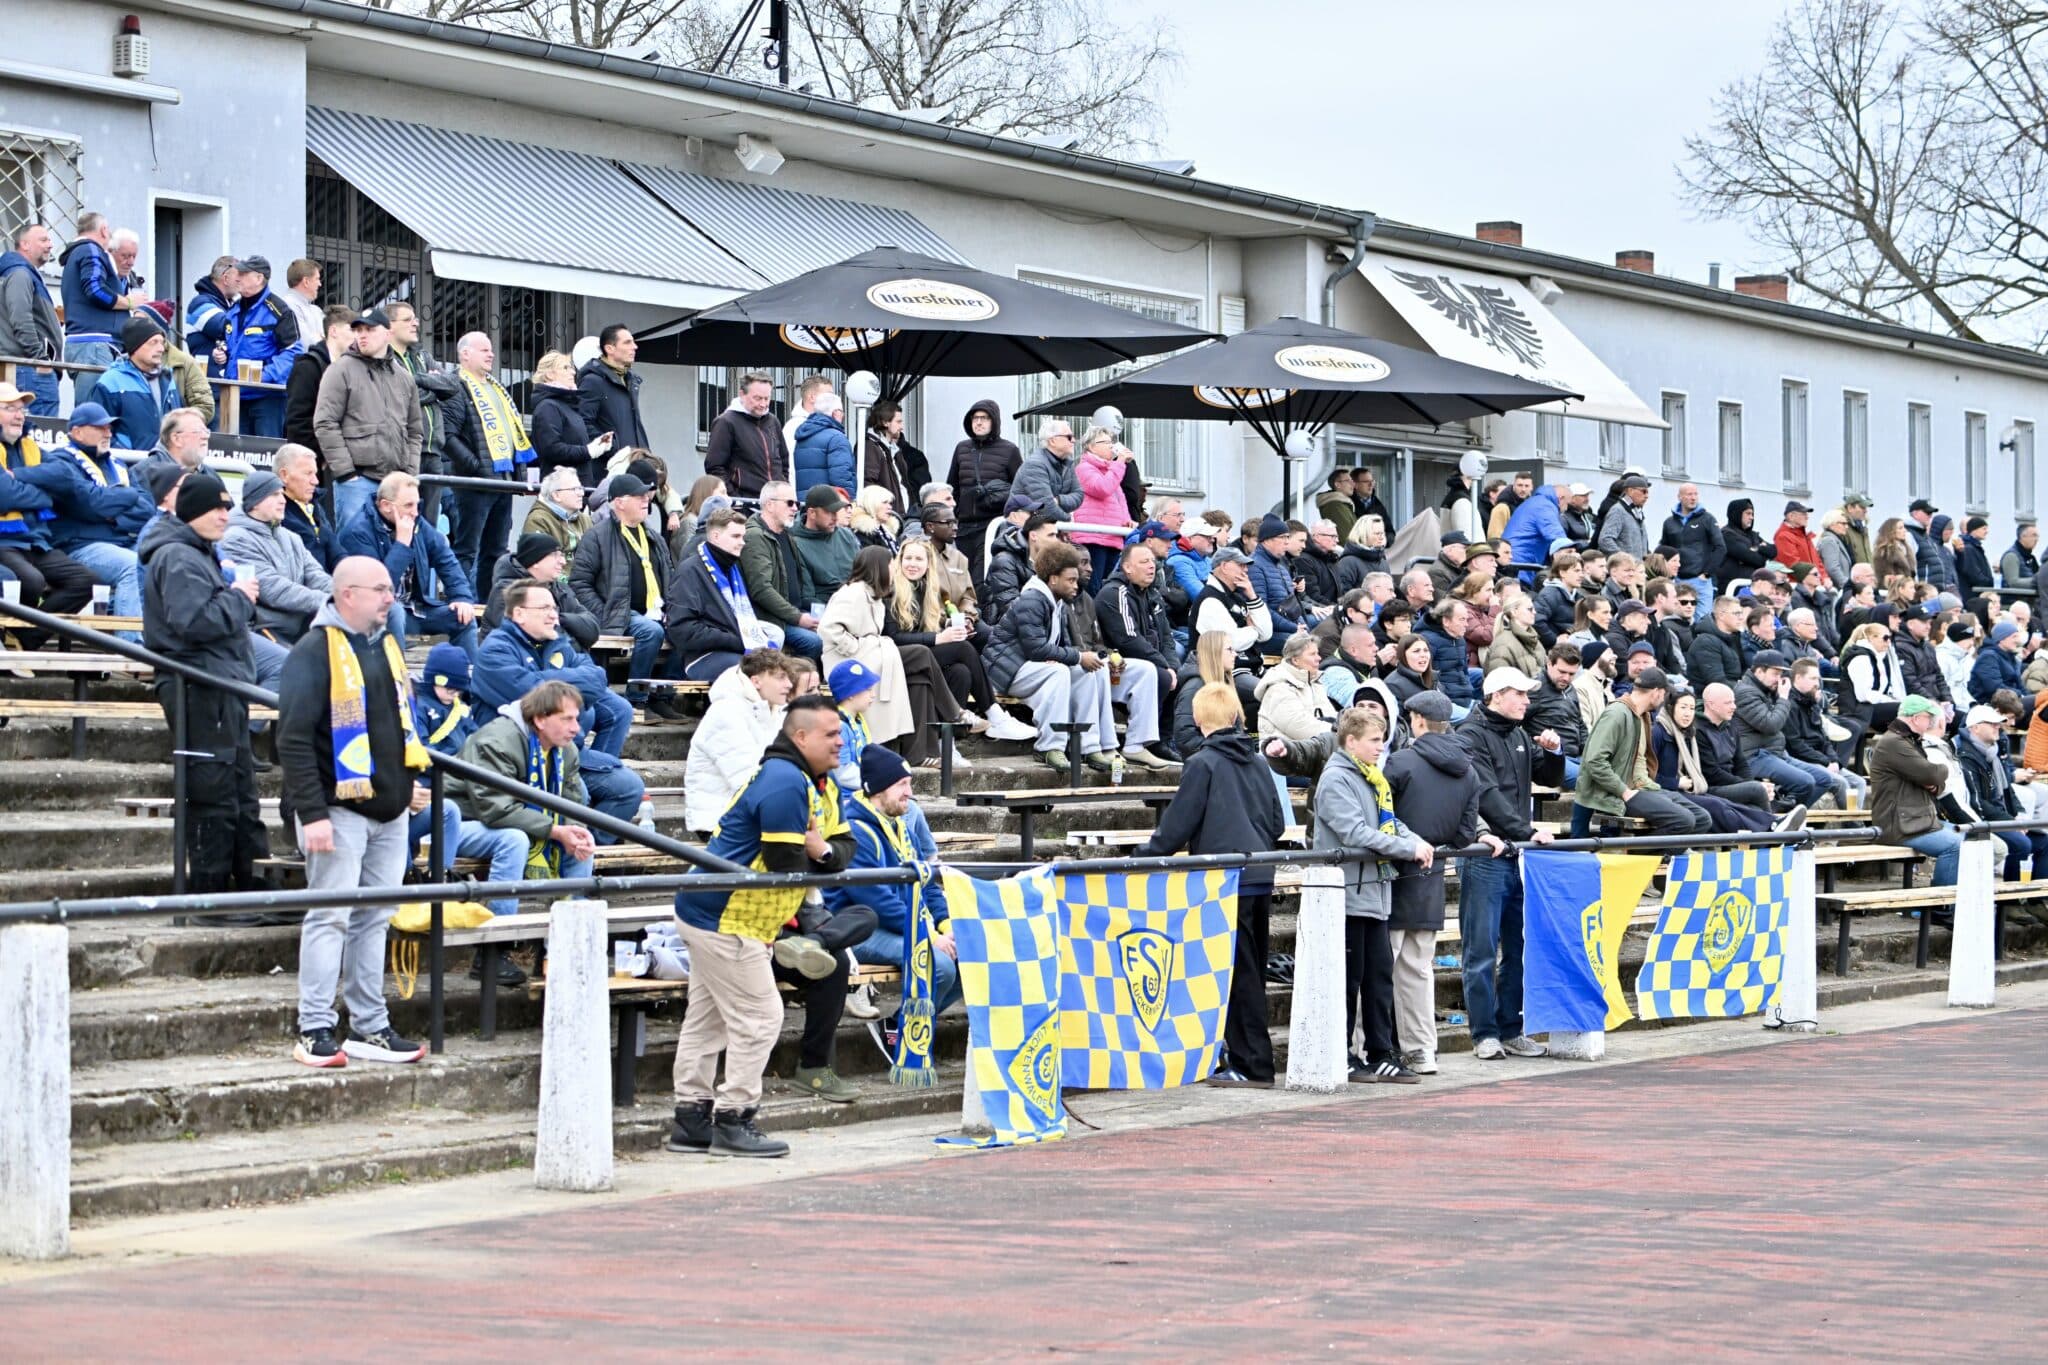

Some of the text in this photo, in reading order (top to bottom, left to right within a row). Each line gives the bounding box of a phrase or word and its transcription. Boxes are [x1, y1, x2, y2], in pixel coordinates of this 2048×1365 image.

[880, 292, 985, 309] Warsteiner
[1286, 357, 1377, 370] Warsteiner
[1126, 937, 1170, 1004] FSV
